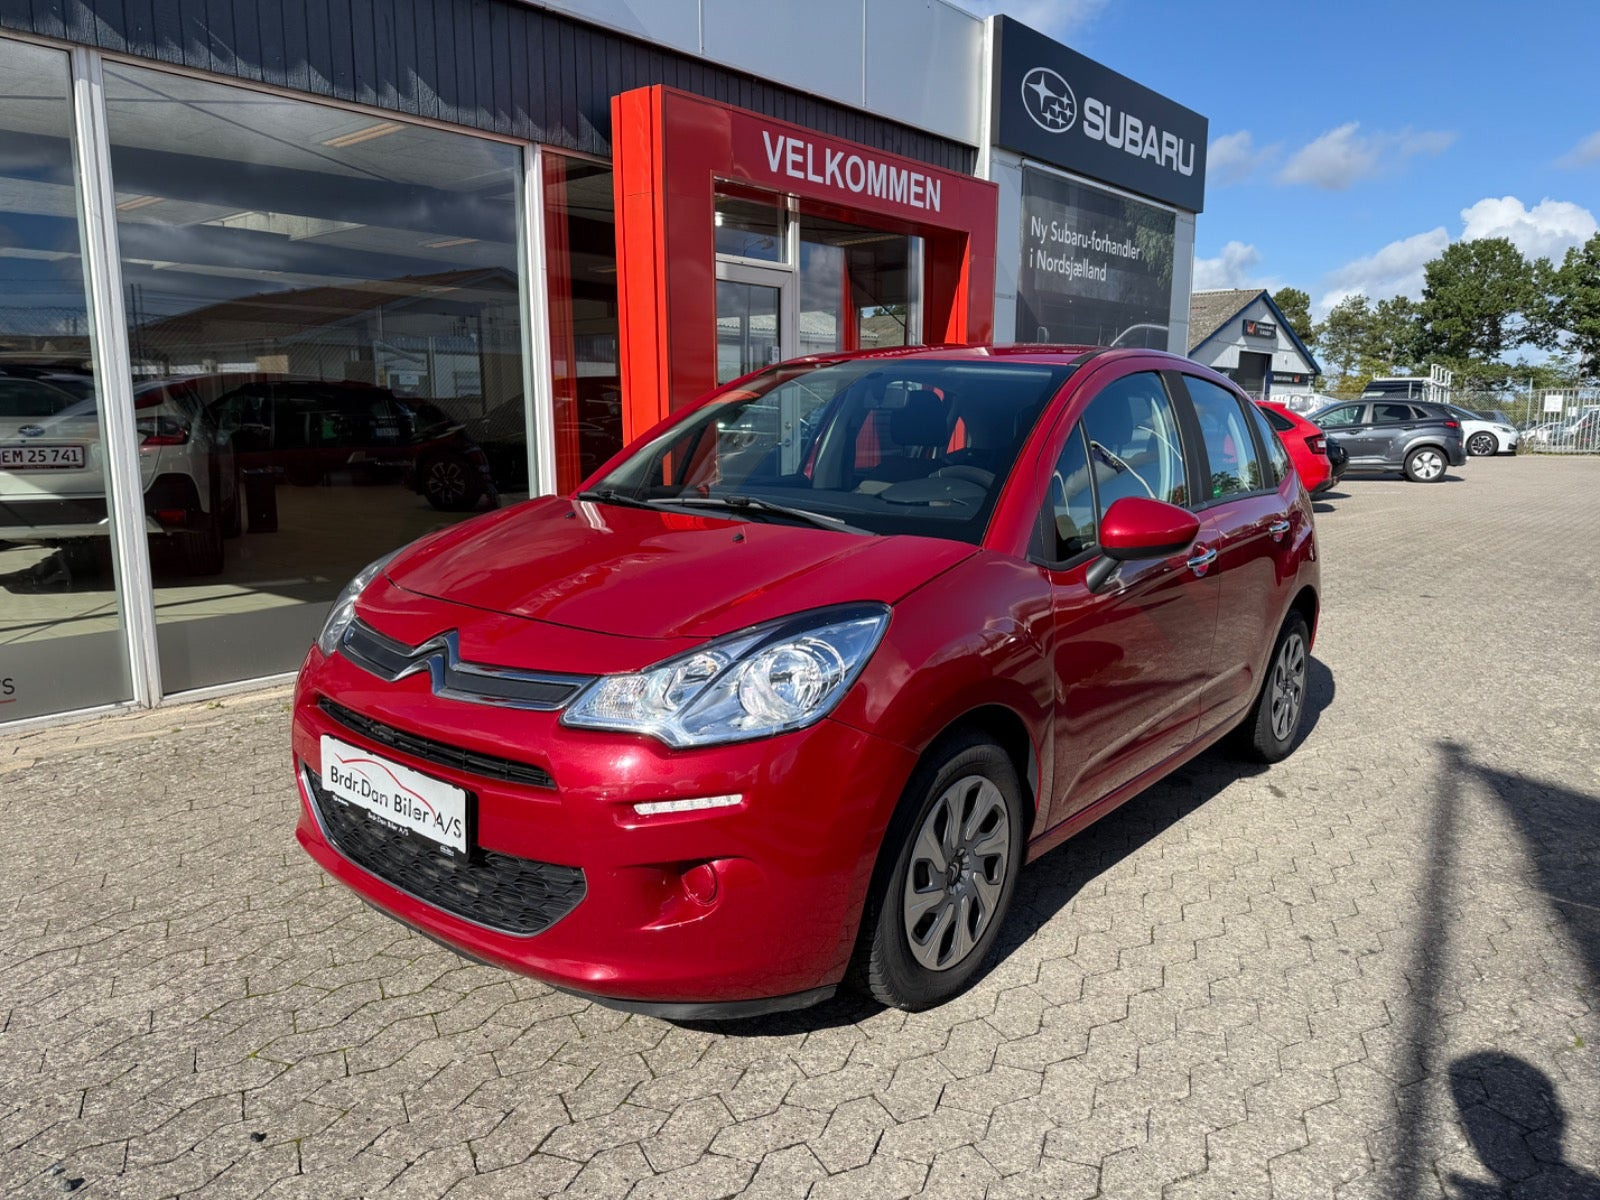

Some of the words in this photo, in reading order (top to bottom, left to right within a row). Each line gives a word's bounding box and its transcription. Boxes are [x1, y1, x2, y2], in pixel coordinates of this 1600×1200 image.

[1083, 97, 1195, 177] SUBARU
[762, 130, 941, 213] VELKOMMEN
[1031, 215, 1048, 244] Ny
[1050, 221, 1141, 260] Subaru-forhandler
[1029, 247, 1034, 268] i
[1036, 249, 1107, 282] Nordsjælland
[1, 449, 24, 463] EM
[27, 449, 47, 463] 25
[50, 449, 79, 462] 741
[393, 794, 430, 823] Biler
[433, 811, 462, 839] A/S
